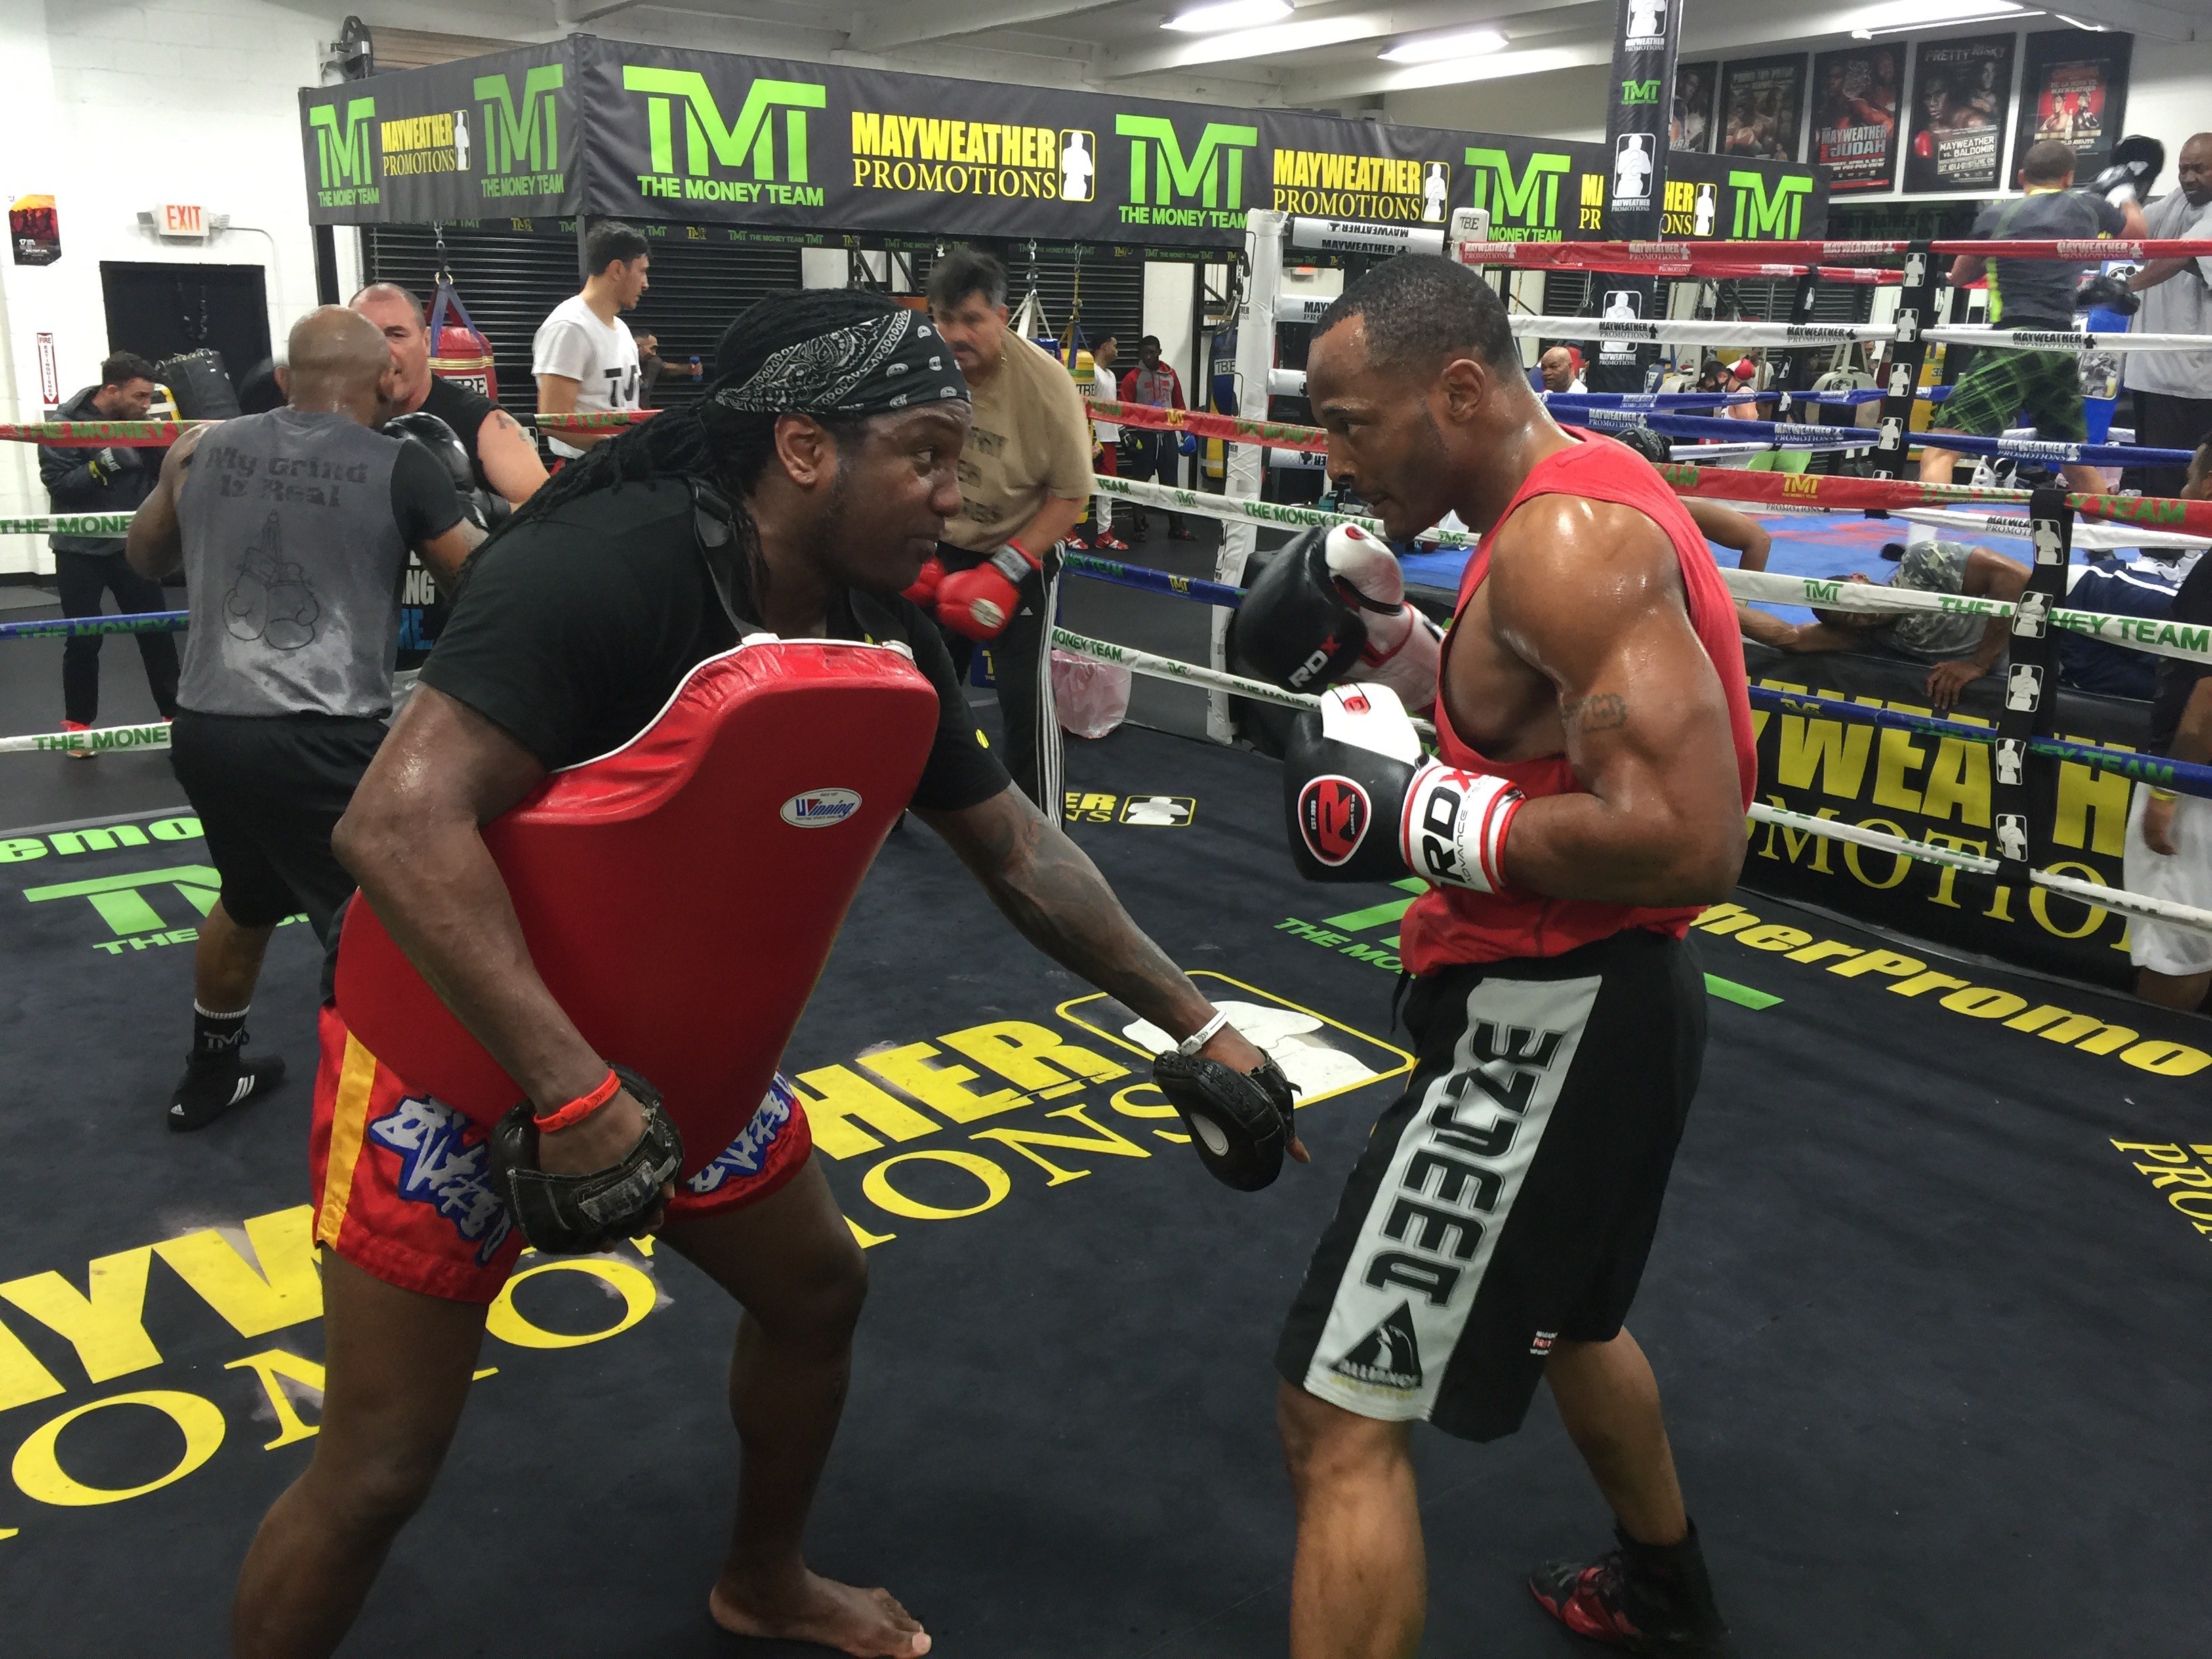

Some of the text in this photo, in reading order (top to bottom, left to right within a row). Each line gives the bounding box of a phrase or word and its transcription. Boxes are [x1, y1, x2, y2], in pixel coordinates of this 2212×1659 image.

[1622, 80, 1661, 100] TMT
[474, 63, 563, 175] TMT
[623, 65, 826, 183] TMT
[310, 96, 375, 188] TMT
[381, 113, 453, 153] MAYWEATHER
[851, 111, 1056, 169] MAYWEATHER
[1821, 125, 1887, 144] MAYWEATHER
[1830, 140, 1886, 157] JUDAH
[1940, 136, 1994, 150] MAYWEATHER
[1954, 144, 1994, 157] BALDOMIR
[383, 148, 456, 176] PROMOTIONS
[1115, 114, 1258, 209] TMT
[853, 158, 1056, 200] PROMOTIONS
[1273, 148, 1420, 195] MAYWEATHER
[480, 173, 565, 198] THE MONEY TEAM
[637, 176, 824, 207] THE MONEY TEAM
[1465, 147, 1571, 227] TMT
[318, 187, 380, 207] THE MONEY TEAM
[1273, 188, 1420, 222] PROMOTIONS
[1728, 171, 1813, 240] TMT
[167, 205, 201, 231] EXIT
[1118, 205, 1248, 229] THE MONEY TEAM
[1460, 216, 1480, 230] TBE
[647, 225, 668, 237] TMT
[728, 230, 747, 241] TMT
[762, 234, 786, 243] MONEY
[804, 233, 824, 245] TMT
[1488, 226, 1562, 243] MONEY TEAM
[1321, 239, 1395, 255] MAYWEATHER
[1465, 243, 1508, 252] MAYWEATHER
[1465, 251, 1509, 260] PROMOTIONS
[1629, 243, 1680, 253] MAYWEATHER
[1629, 252, 1682, 261] PROMOTIONS
[1822, 243, 1883, 254] MAYWEATHER
[2057, 241, 2129, 253] MAYWEATHER
[1599, 322, 1648, 332] MAYWEATHER
[1599, 330, 1649, 340] PROMOTIONS
[1787, 327, 1845, 337] MAYWEATHER
[2013, 331, 2082, 344] MAYWEATHER
[1599, 353, 1636, 361] MAYWEATHER
[1589, 409, 1637, 422] MAYWEATHER
[1589, 418, 1637, 429] PROMOTIONS
[15, 421, 165, 440] THE MONEY
[1263, 425, 1320, 445] MONEY
[1774, 424, 1832, 436] MAYWEATHER
[1774, 433, 1834, 443] PROMOTIONS
[1997, 438, 2067, 453] MAYWEATHER
[1997, 449, 2066, 462] PROMOTIONS
[205, 447, 369, 484] My Grind
[1096, 477, 1131, 495] TEAM
[1783, 473, 1824, 494] TMT
[1174, 490, 1198, 504] TMT
[1243, 501, 1271, 520] THE
[1273, 506, 1329, 527] MONEY
[1765, 503, 1824, 514] PROMOTIONS
[2097, 495, 2188, 525] TEAM
[0, 518, 49, 534] THE
[1090, 559, 1124, 577] TEAM
[1168, 574, 1190, 589] TMT
[1803, 579, 1844, 601] TMT
[75, 618, 171, 636] MONEY
[2117, 618, 2211, 653] TEAM
[1089, 641, 1123, 662] TEAM
[1289, 630, 1340, 689] RDX
[32, 733, 85, 750] THE
[2084, 750, 2175, 781] TEAM
[795, 799, 855, 819] Winning
[1422, 768, 1484, 884] RDX
[92, 927, 200, 955] THE
[1274, 916, 1352, 947] THE
[796, 1020, 1132, 1161] HER
